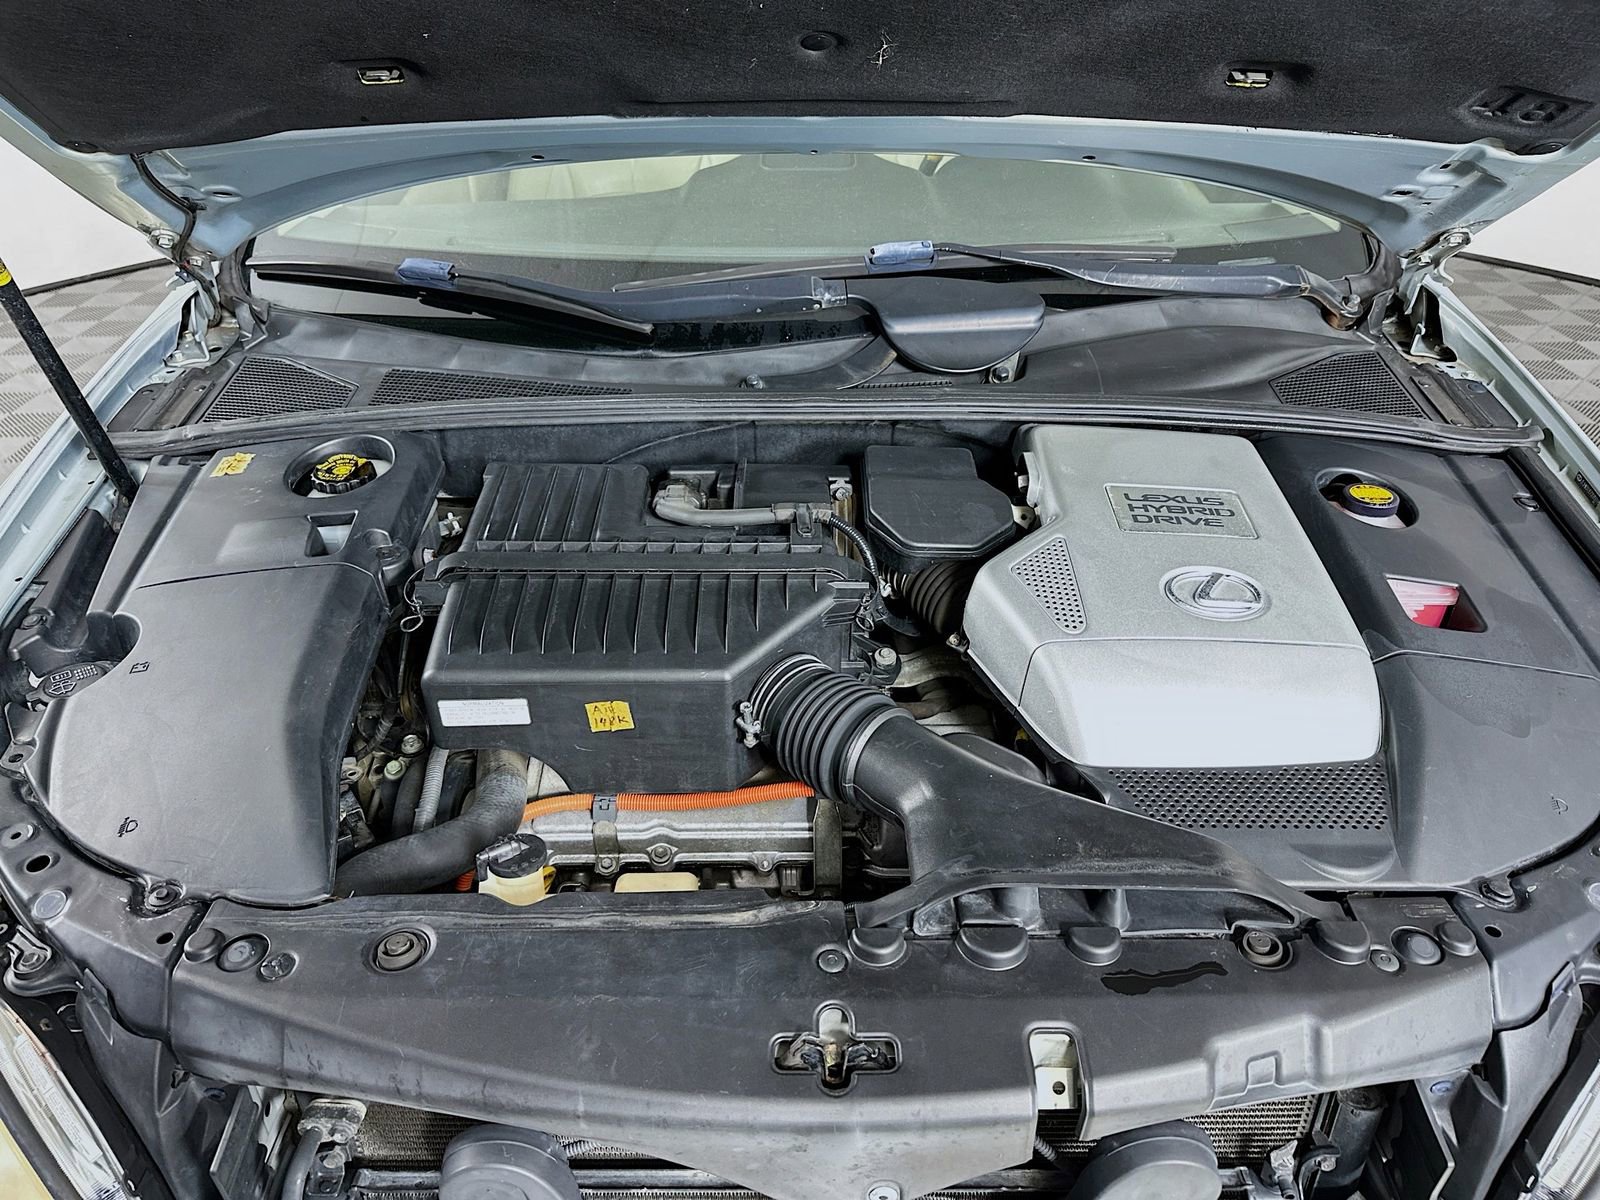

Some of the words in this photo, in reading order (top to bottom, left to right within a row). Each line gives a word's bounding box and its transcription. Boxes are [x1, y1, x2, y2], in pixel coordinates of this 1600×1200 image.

[1123, 493, 1225, 506] LEXUS
[1127, 503, 1236, 517] HYBRID
[1131, 514, 1225, 528] DRIVE
